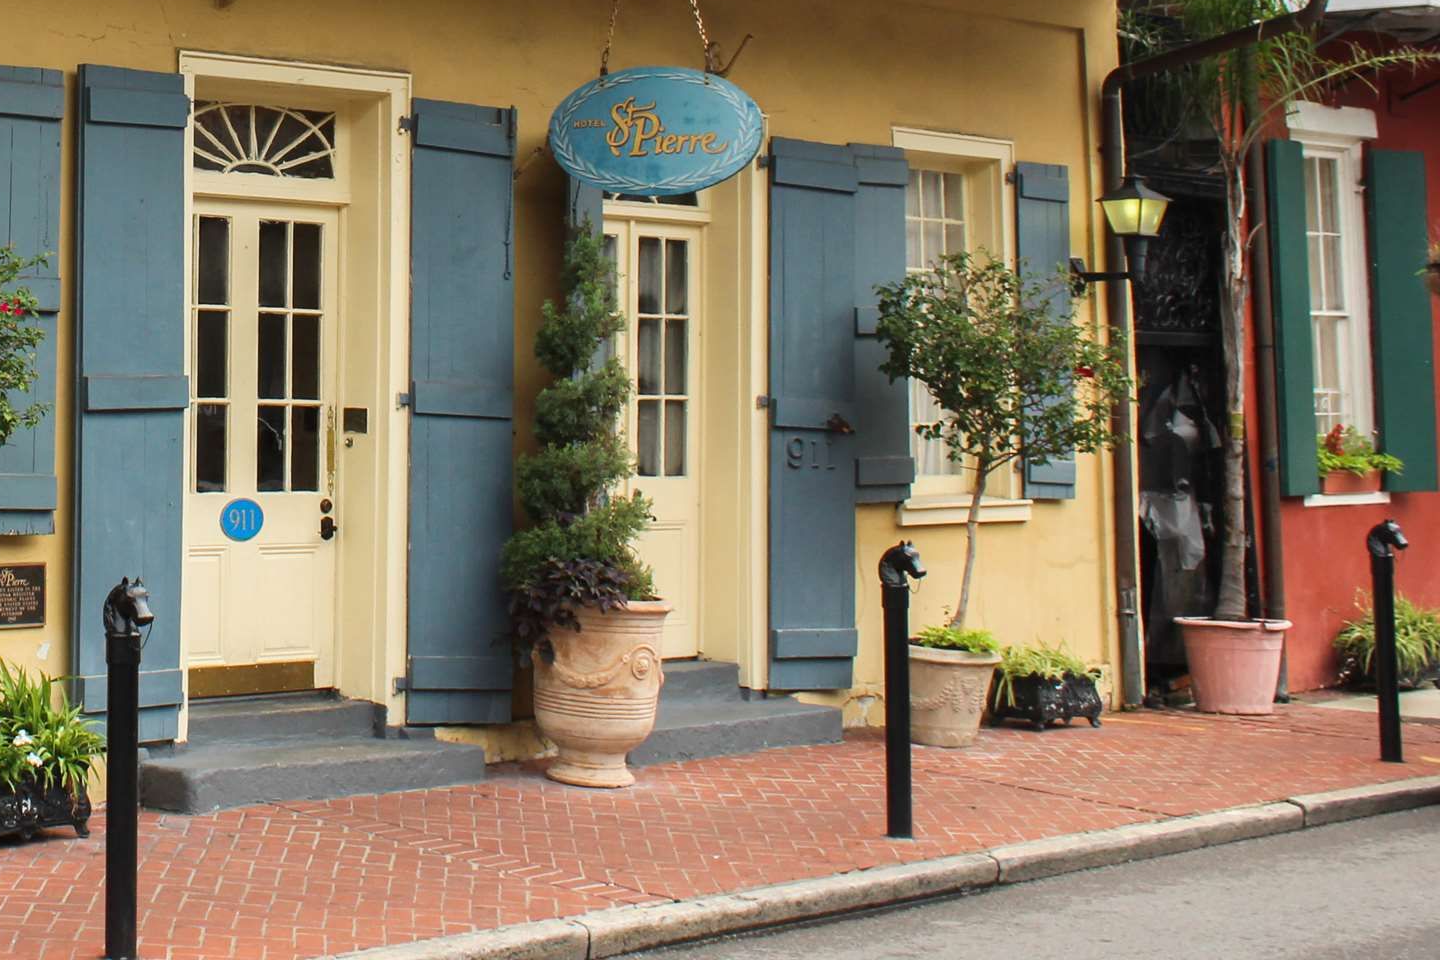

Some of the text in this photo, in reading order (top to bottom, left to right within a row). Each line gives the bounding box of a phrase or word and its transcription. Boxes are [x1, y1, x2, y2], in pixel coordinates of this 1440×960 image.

[573, 118, 606, 129] HOTEL
[629, 110, 728, 157] Pierre
[786, 437, 836, 470] 911
[229, 509, 255, 530] 911
